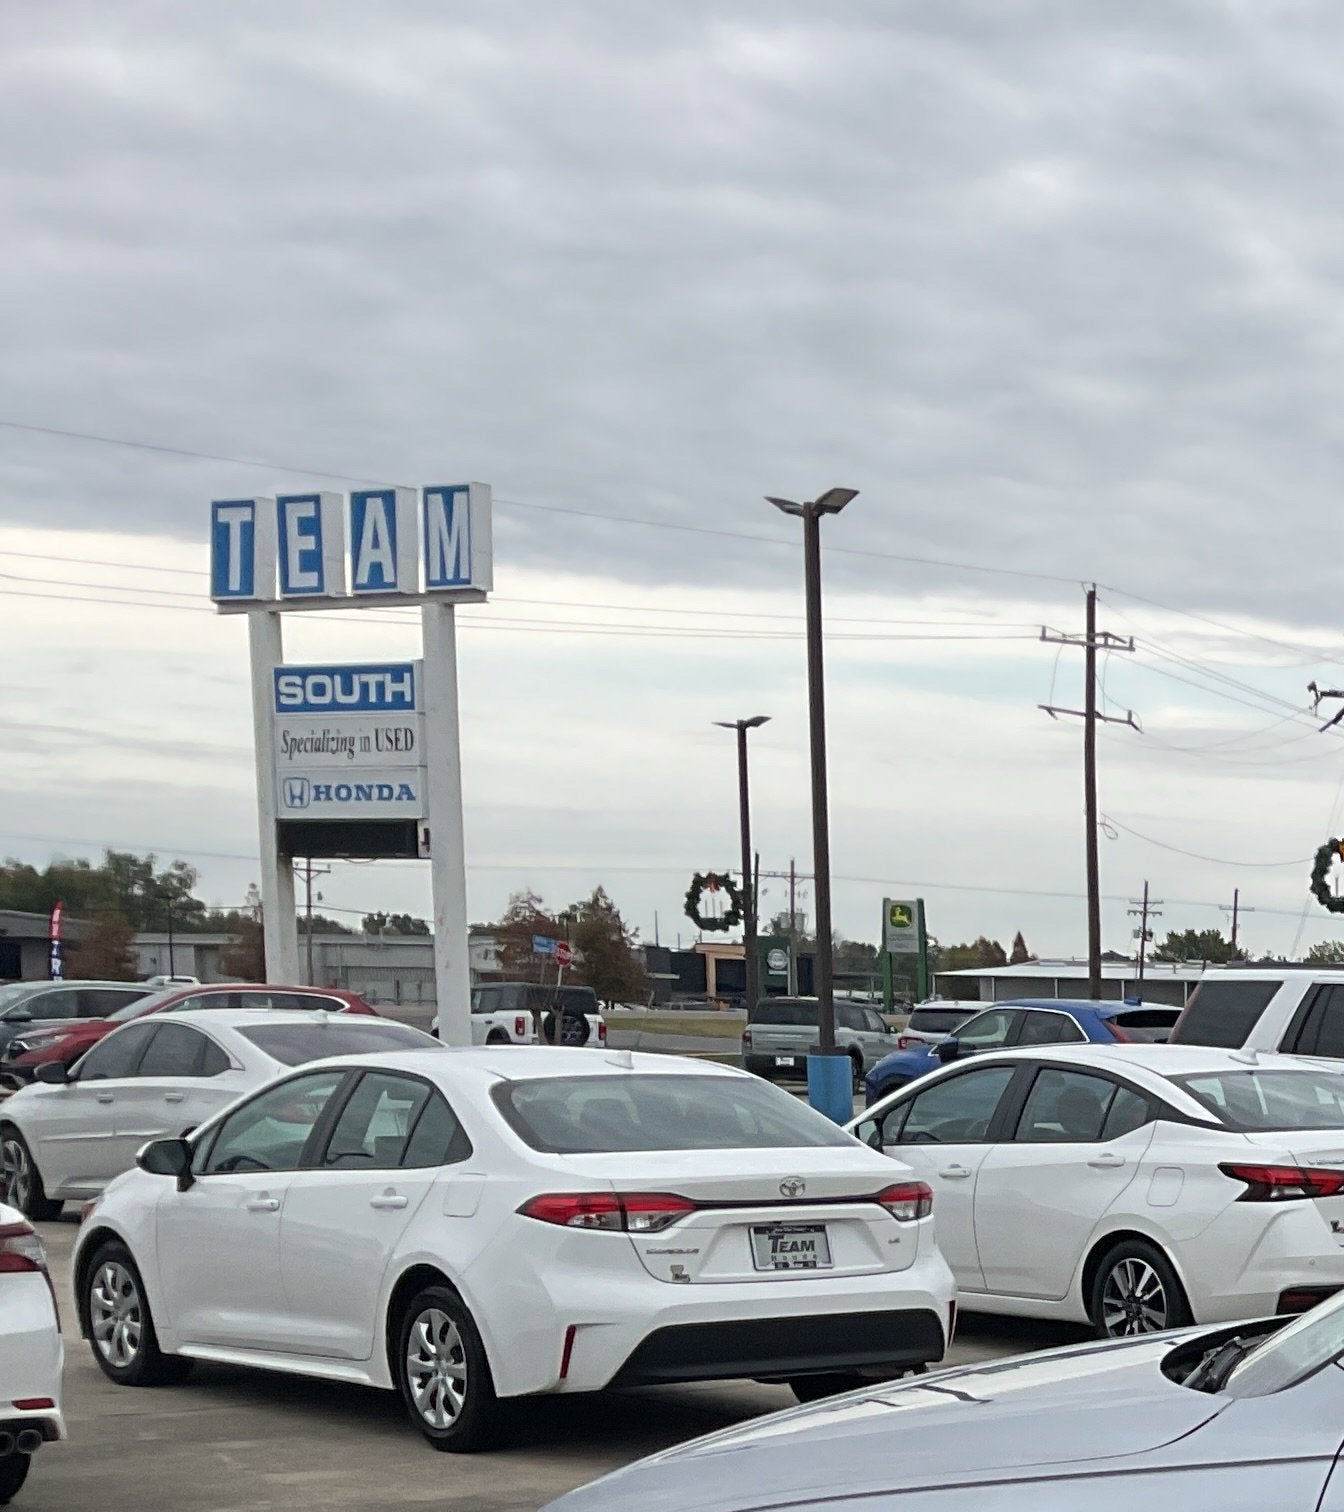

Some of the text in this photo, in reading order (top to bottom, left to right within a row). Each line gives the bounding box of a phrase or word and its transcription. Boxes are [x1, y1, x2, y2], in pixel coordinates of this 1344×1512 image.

[216, 492, 471, 592] TEAM
[278, 672, 412, 705] SOUTH
[281, 727, 415, 760] Specializing in USED
[312, 783, 417, 802] HONDA
[768, 1233, 815, 1254] TEAM
